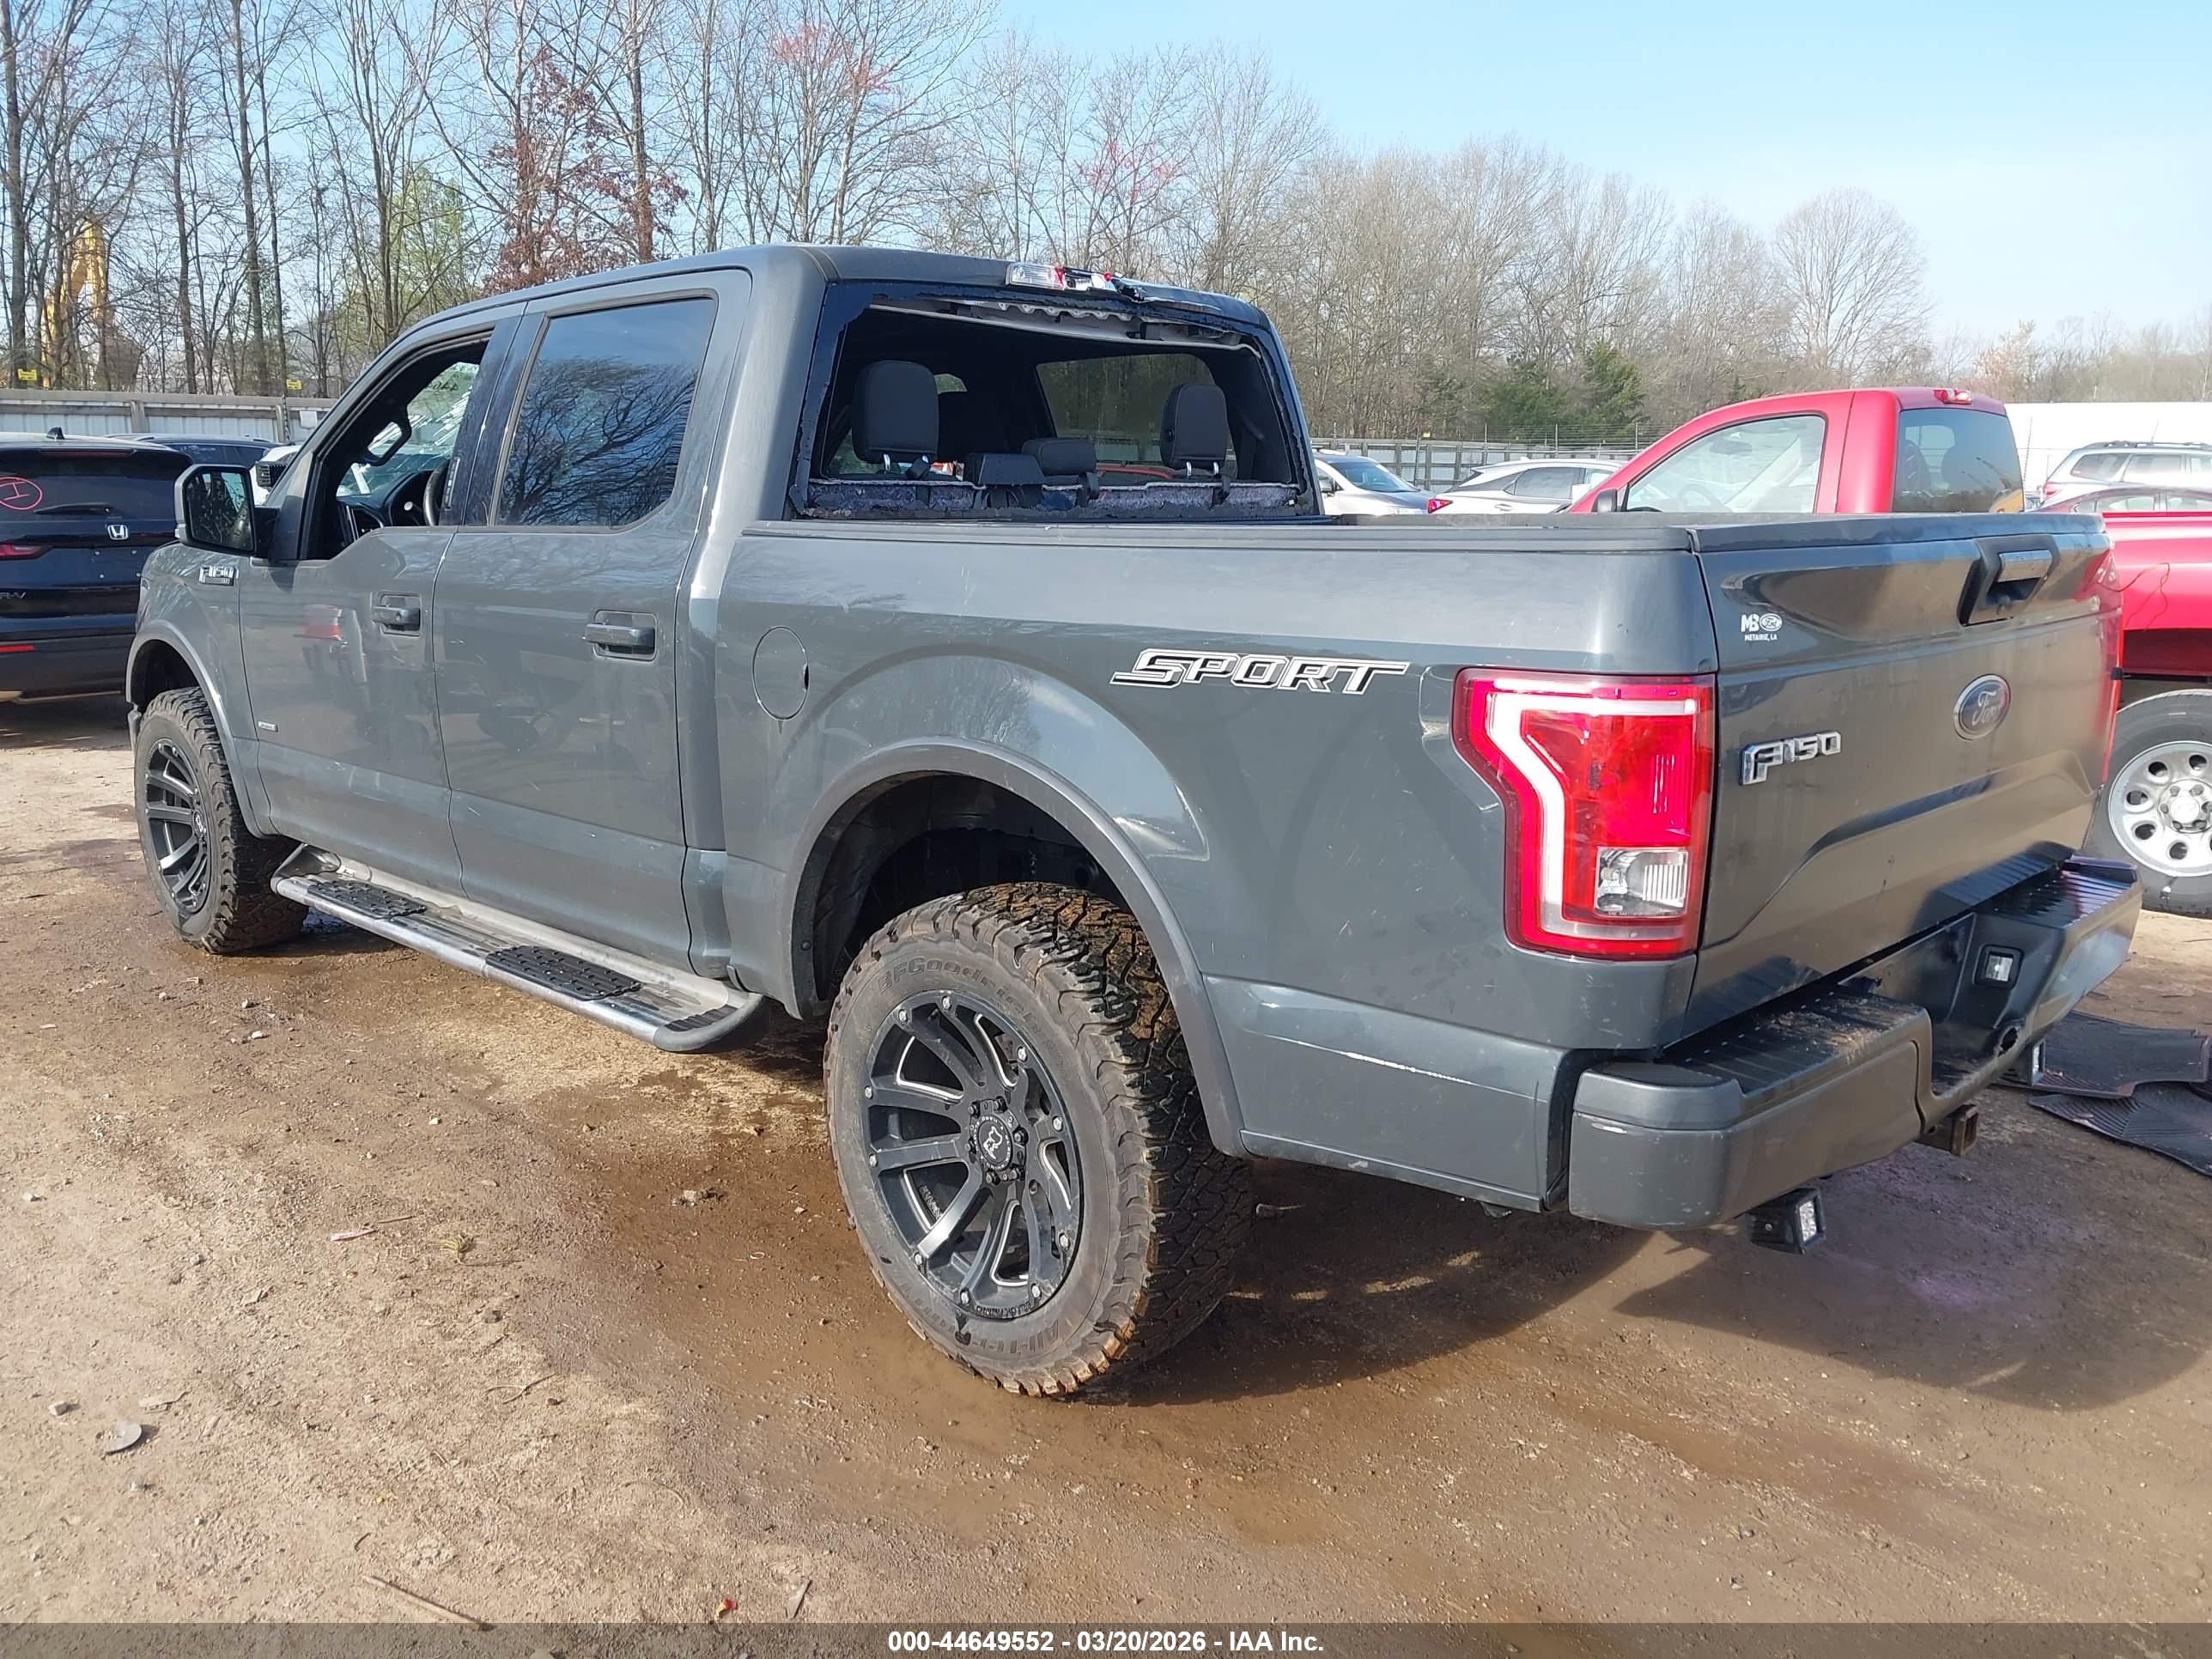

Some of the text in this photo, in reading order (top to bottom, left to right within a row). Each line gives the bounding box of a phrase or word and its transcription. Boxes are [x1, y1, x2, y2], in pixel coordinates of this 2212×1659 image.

[0, 591, 27, 599] R-V
[1110, 647, 1411, 695] SPORT
[1742, 731, 1842, 785] F150
